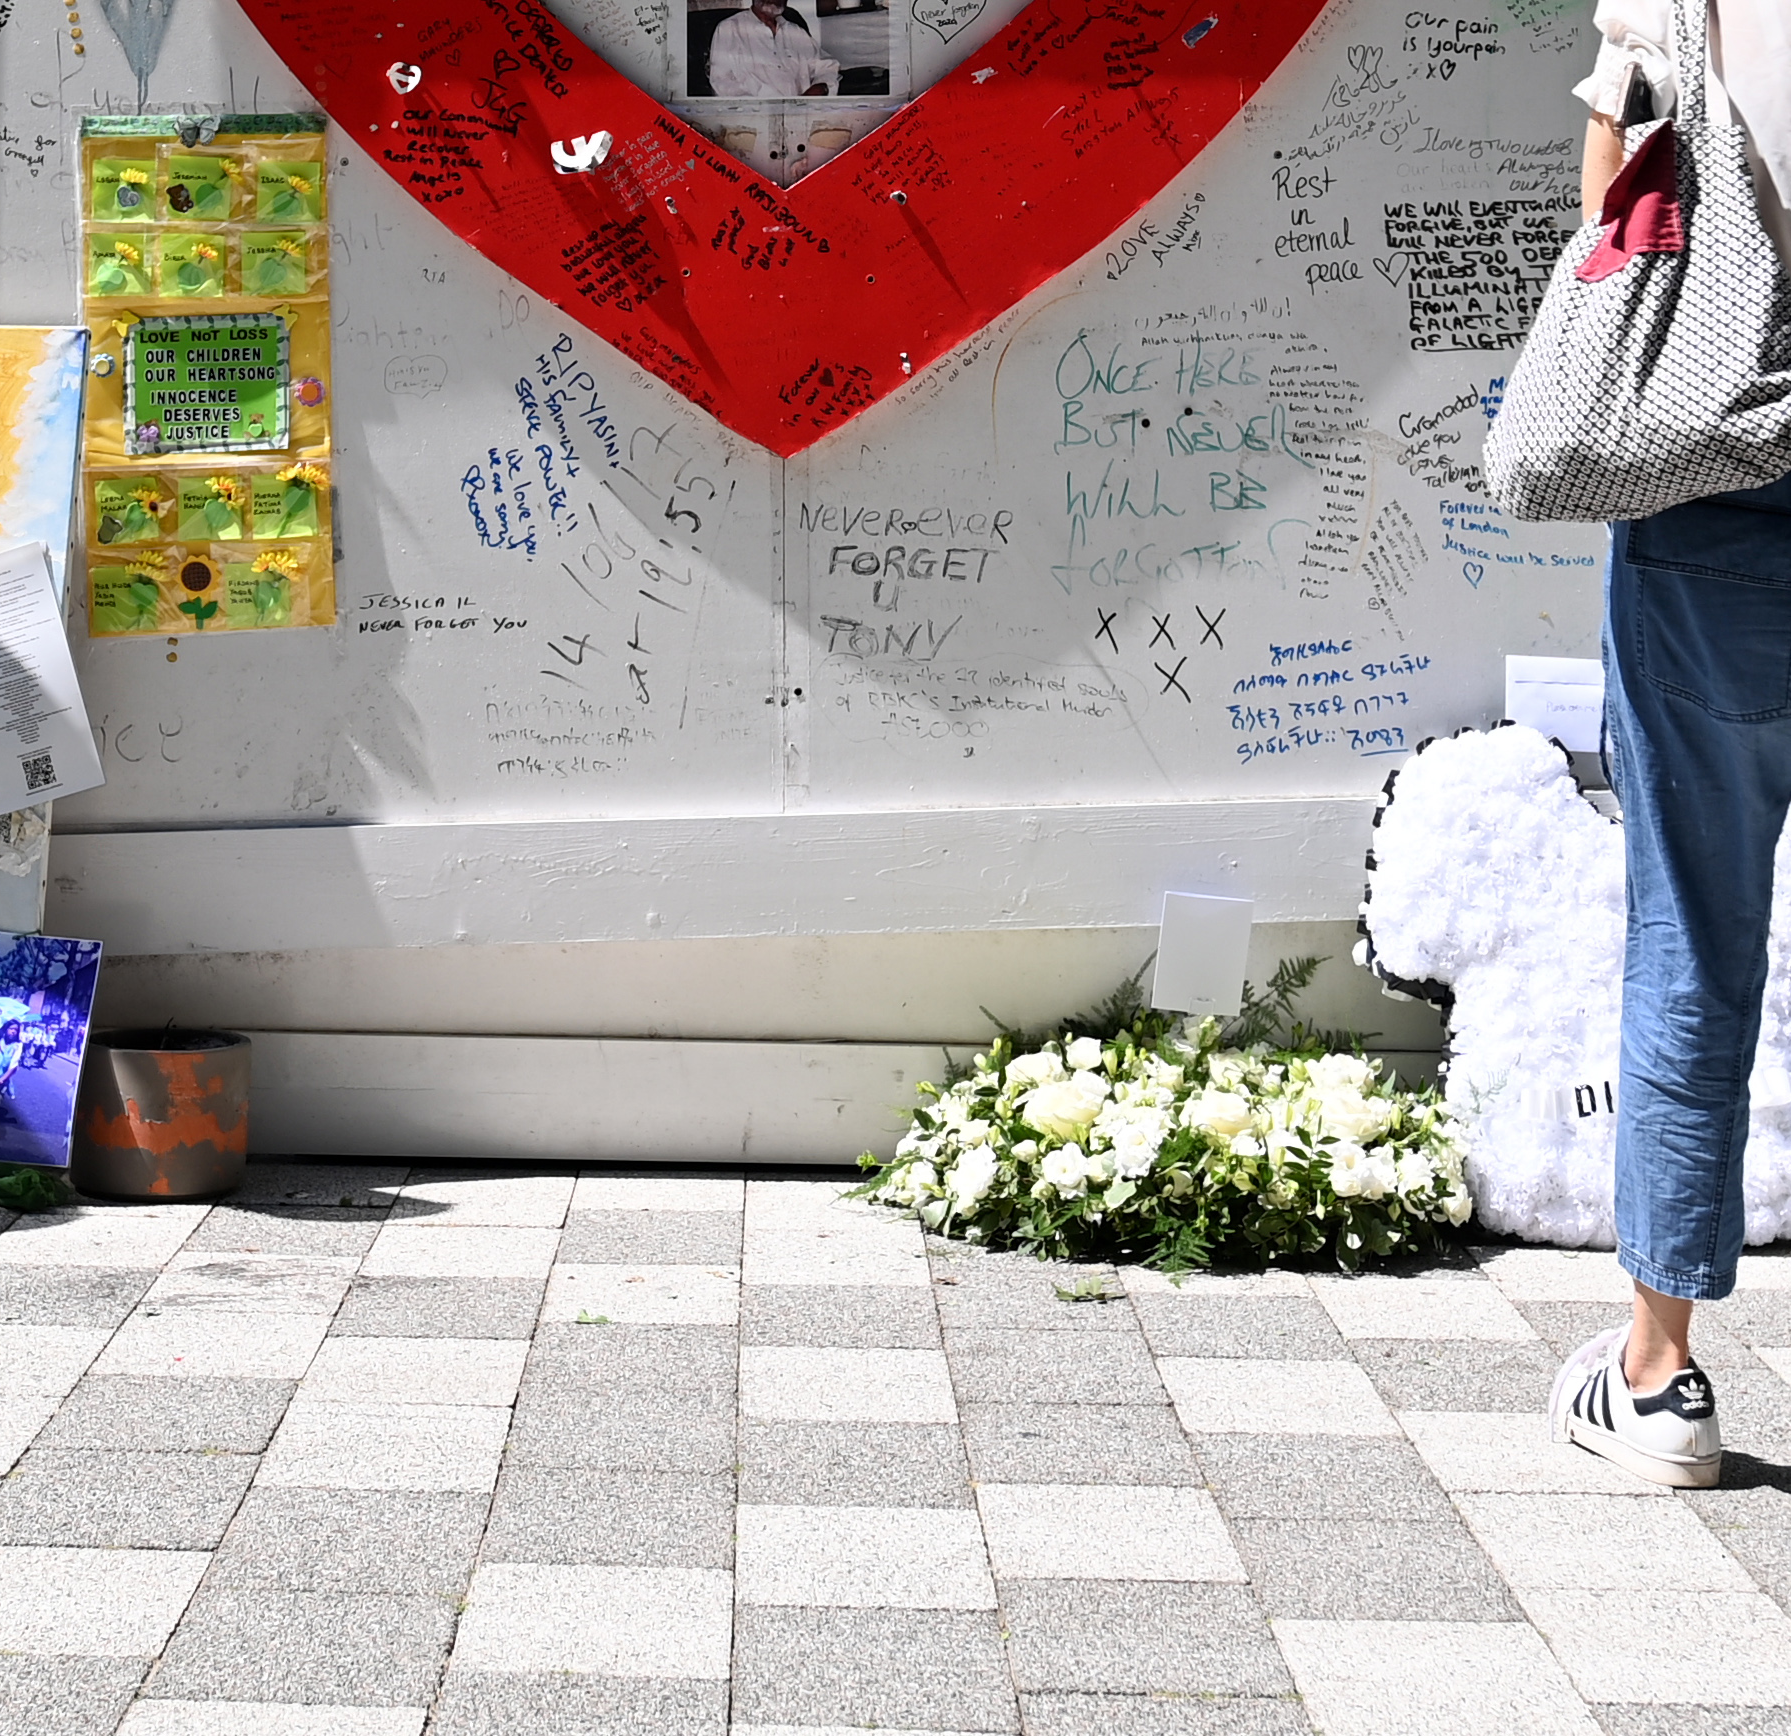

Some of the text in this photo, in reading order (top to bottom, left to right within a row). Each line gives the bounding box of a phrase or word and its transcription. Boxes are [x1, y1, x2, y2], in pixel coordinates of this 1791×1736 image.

[1271, 165, 1338, 201] Rest
[1290, 209, 1316, 226] in
[1274, 216, 1357, 258] eternal
[1305, 259, 1363, 296] peace
[140, 332, 179, 343] LOVE
[230, 329, 268, 340] LOSS
[146, 348, 261, 363] OUR CHILDREN
[145, 367, 275, 382] OUR HEARTSONG
[151, 389, 237, 404] INNOCENCE
[163, 408, 240, 422] DESERVES
[166, 425, 229, 439] JUSTICE
[1053, 401, 1144, 456] BUT
[828, 545, 1002, 584] FORGET
[359, 593, 445, 610] JESSICA
[873, 580, 901, 612] U
[359, 616, 527, 633] NEVER FORGET YOU
[819, 614, 963, 661] TONY
